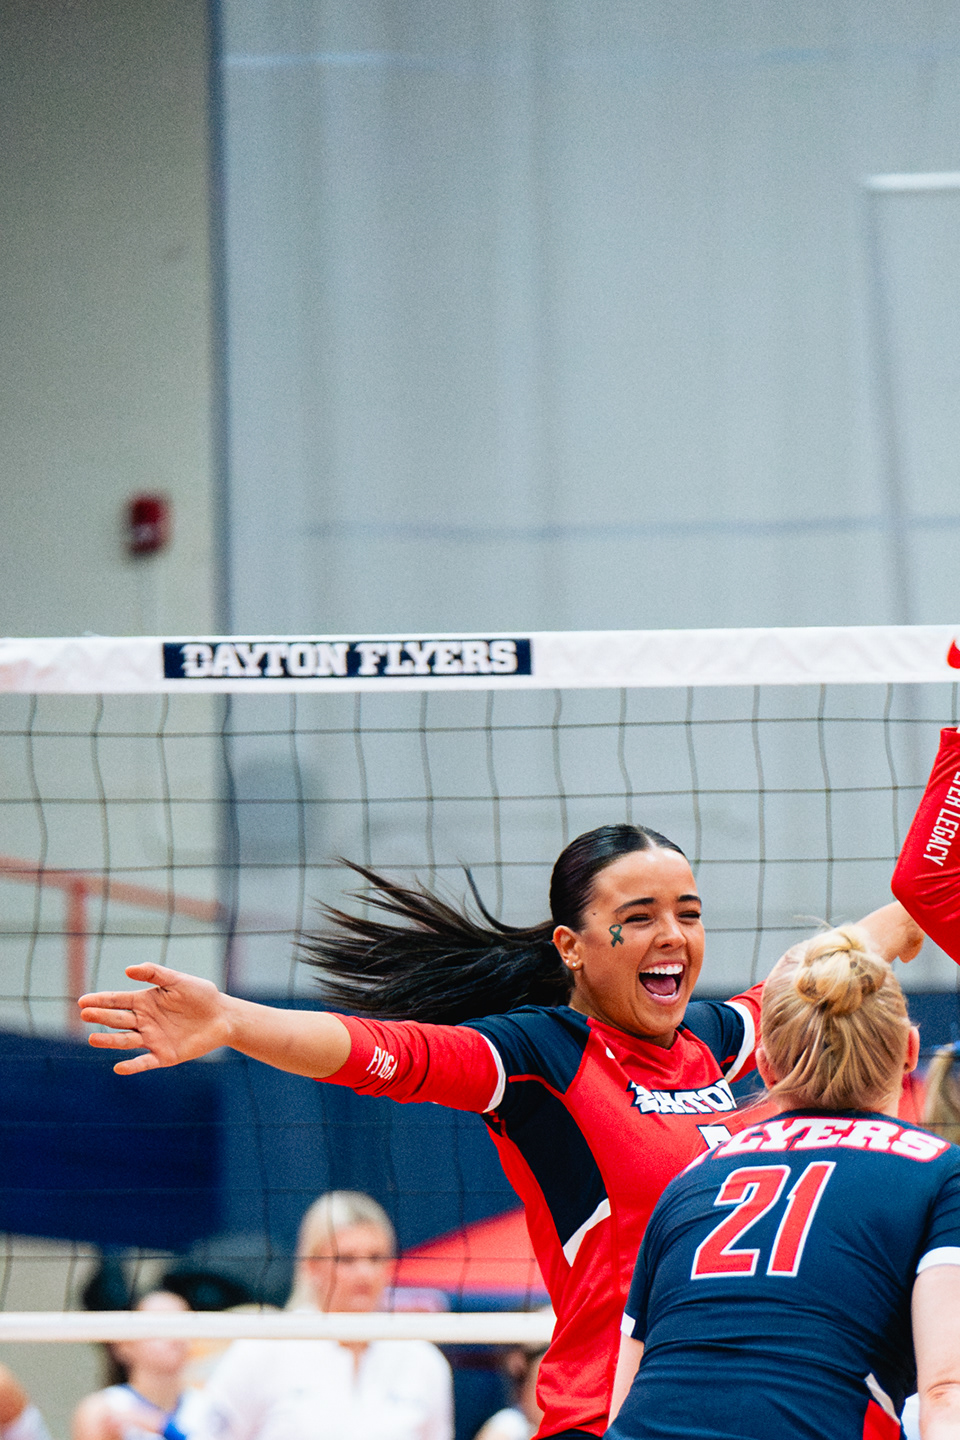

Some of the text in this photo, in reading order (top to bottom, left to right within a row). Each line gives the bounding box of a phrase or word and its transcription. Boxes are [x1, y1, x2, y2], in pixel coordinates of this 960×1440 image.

[180, 640, 519, 678] DAYTON FLYERS
[680, 1116, 951, 1178] LYERS
[690, 1160, 837, 1280] 21
